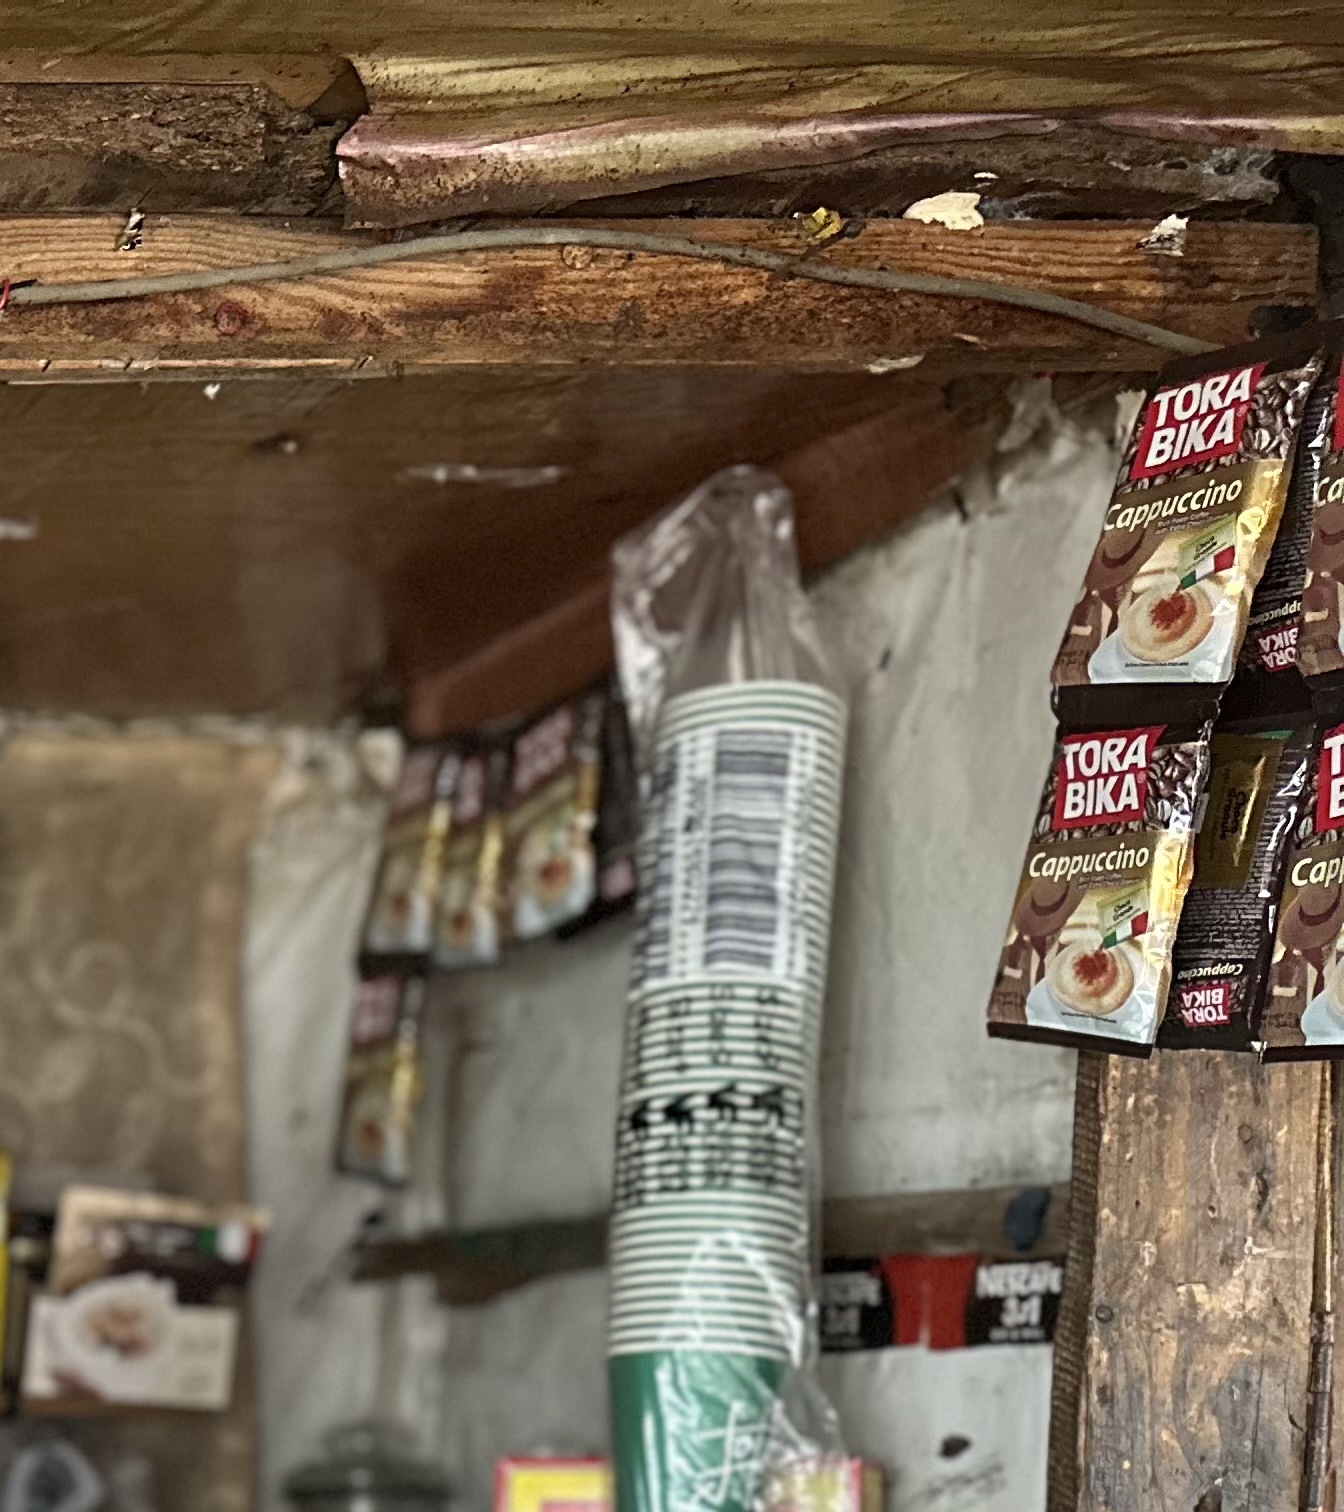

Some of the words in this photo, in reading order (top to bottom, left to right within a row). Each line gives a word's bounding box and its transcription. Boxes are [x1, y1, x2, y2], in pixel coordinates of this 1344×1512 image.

[1153, 367, 1253, 427] TORA
[1144, 408, 1235, 468] BIKA
[1103, 479, 1243, 532] Cappuccino
[1261, 647, 1297, 668] ORA
[1063, 734, 1148, 780] TORA
[1063, 773, 1139, 820] BIKA
[1029, 843, 1149, 882] Cappuccino
[1181, 1005, 1228, 1024] TORA
[1182, 988, 1224, 1008] BIKA
